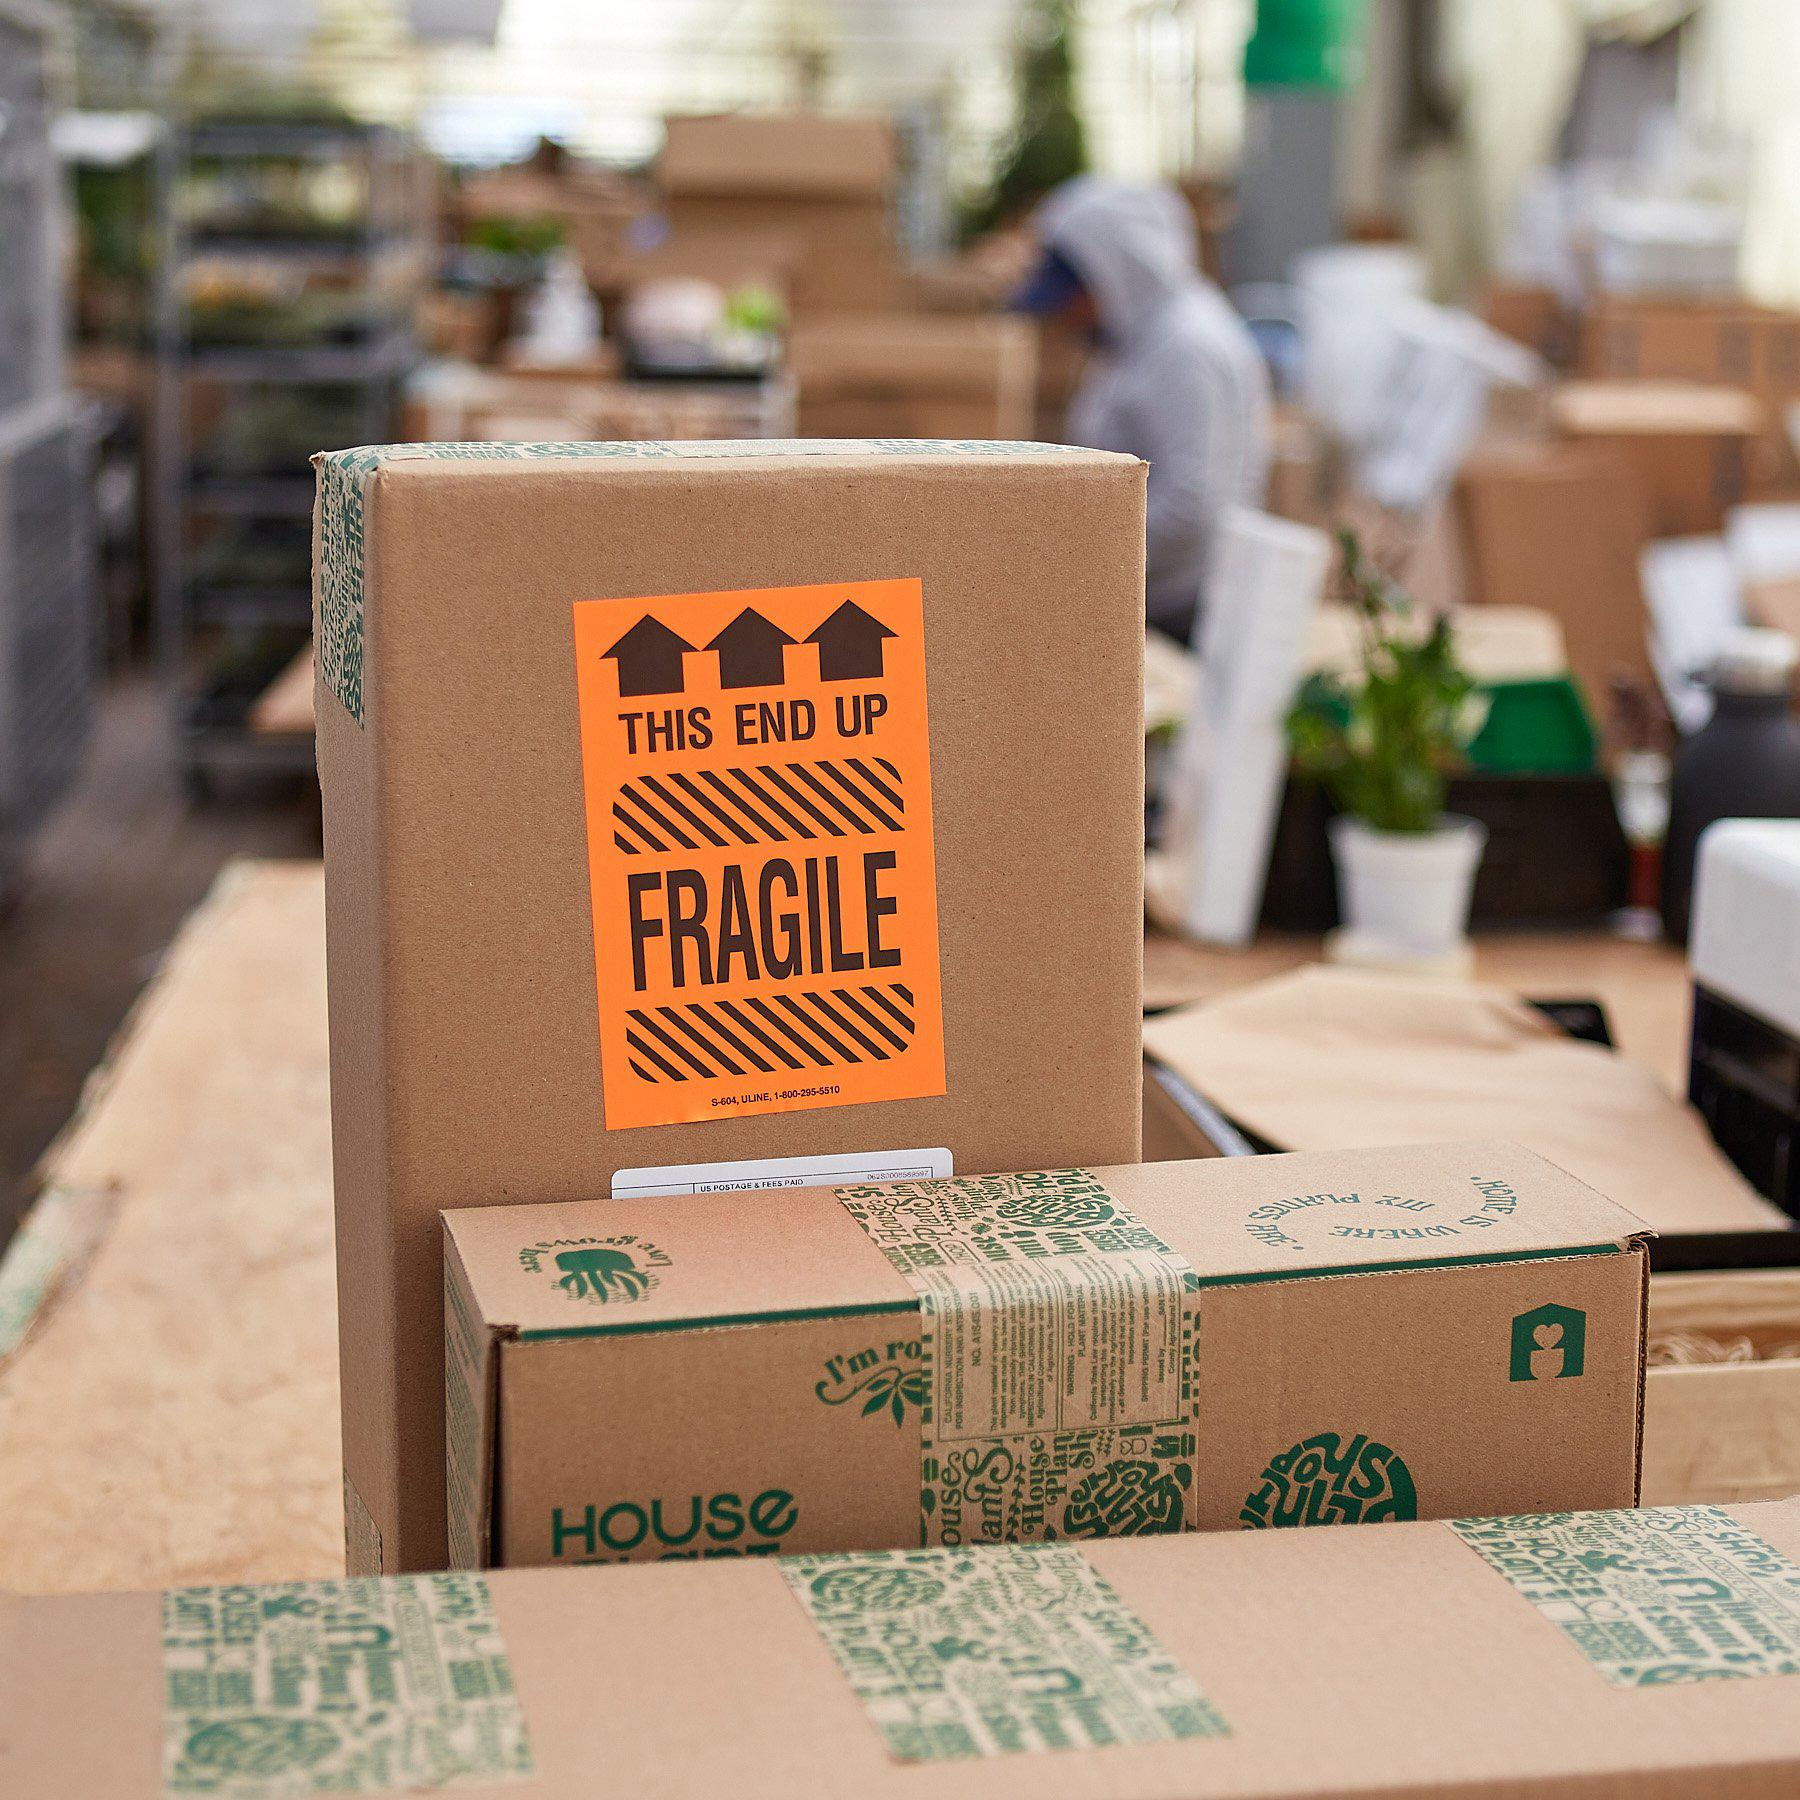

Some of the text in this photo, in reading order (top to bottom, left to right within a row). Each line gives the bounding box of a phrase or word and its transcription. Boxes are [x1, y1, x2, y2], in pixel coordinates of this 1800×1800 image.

[618, 693, 888, 755] THIS END UP
[627, 850, 902, 991] FRAGILE
[711, 1085, 840, 1107] S-604, ULINE, 1-800-295-5510
[714, 1182, 752, 1191] POSTAGE
[754, 1181, 760, 1189] &
[762, 1180, 783, 1188] FEES
[784, 1178, 804, 1187] PAID
[1460, 1215, 1499, 1228] IS
[1329, 1224, 1461, 1240] WHERE
